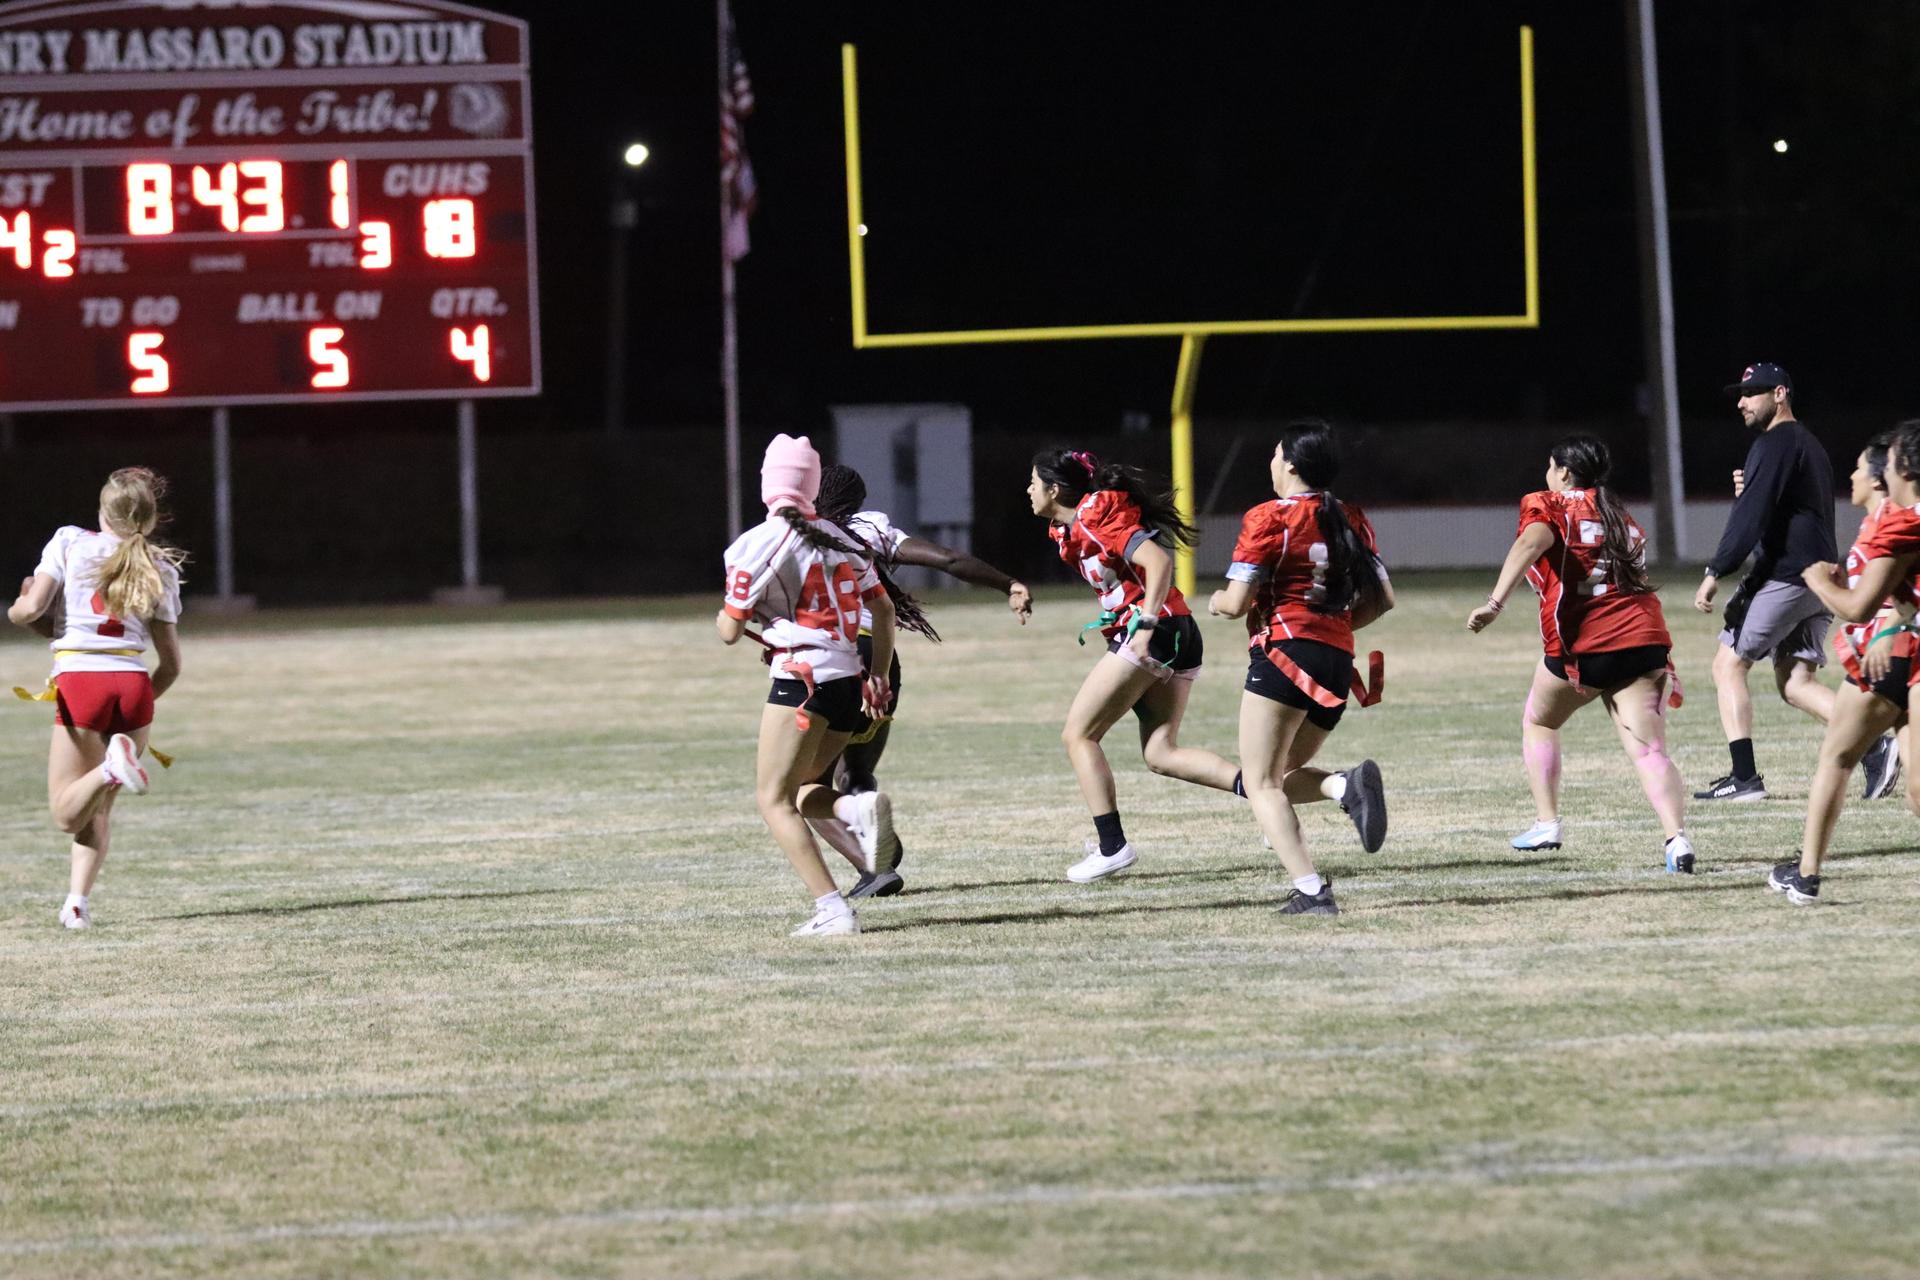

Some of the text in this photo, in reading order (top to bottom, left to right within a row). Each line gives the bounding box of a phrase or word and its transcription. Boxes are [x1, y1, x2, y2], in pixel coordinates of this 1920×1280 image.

[82, 25, 283, 71] MASSARO
[293, 21, 486, 67] STADIUM
[145, 93, 200, 150] of
[211, 92, 284, 137] the
[296, 88, 438, 136] Tribe!
[43, 229, 76, 277] 2
[359, 221, 392, 269] 3
[81, 295, 180, 327] TO GO
[238, 290, 382, 323] BALL ON
[129, 332, 170, 393] 5
[309, 327, 350, 388] 5
[449, 323, 490, 382] 4
[1713, 784, 1737, 798] HOKA
